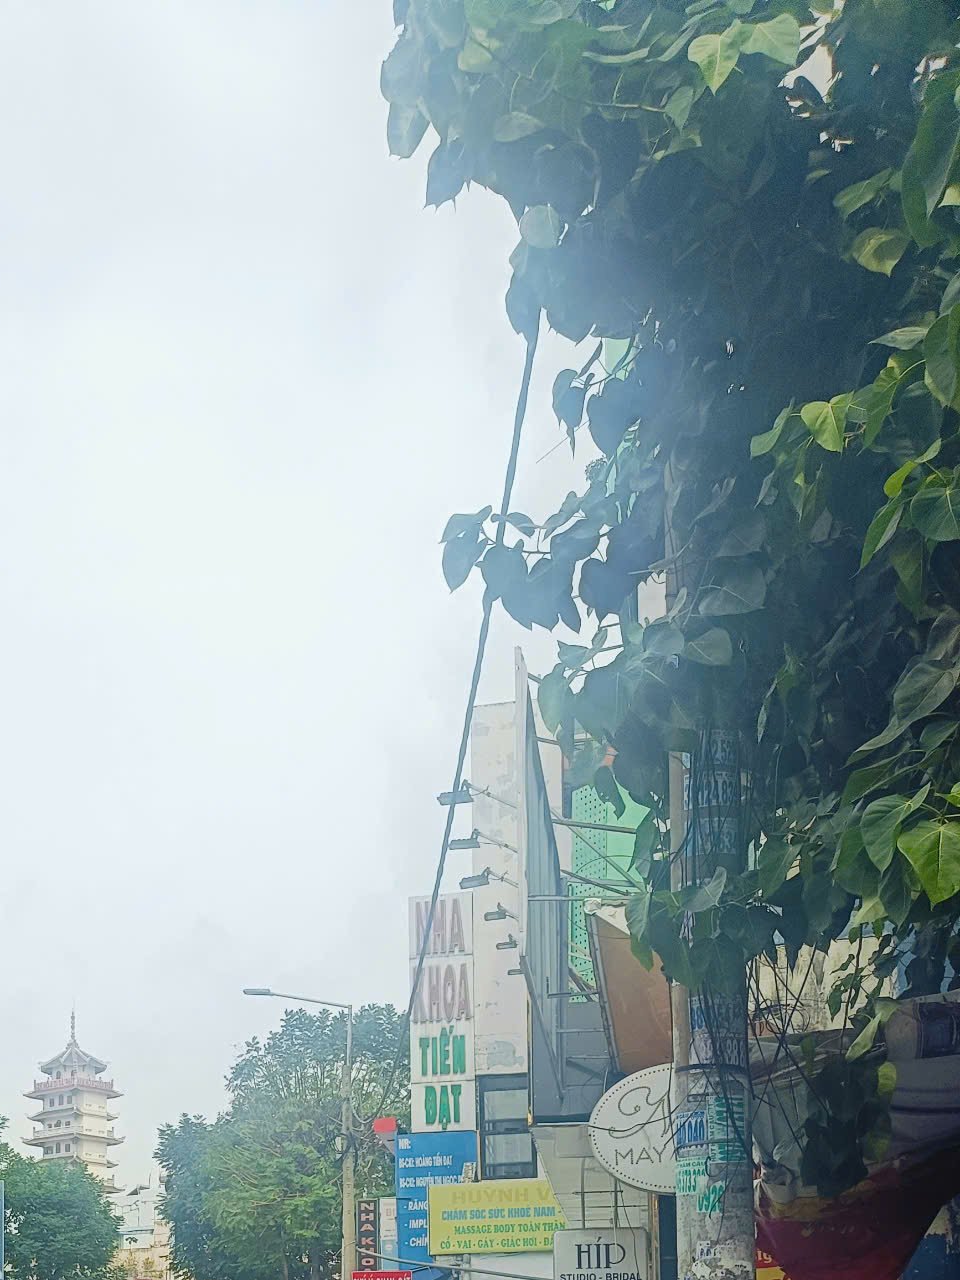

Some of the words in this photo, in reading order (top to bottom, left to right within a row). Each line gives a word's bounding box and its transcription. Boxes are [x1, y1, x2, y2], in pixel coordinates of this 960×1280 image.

[419, 1026, 467, 1076] TIẾN
[425, 1084, 462, 1130] ĐẠT
[534, 1206, 556, 1217] NAM
[454, 1224, 492, 1235] MASSAGE
[494, 1223, 516, 1234] BODY
[457, 1239, 471, 1249] VAI
